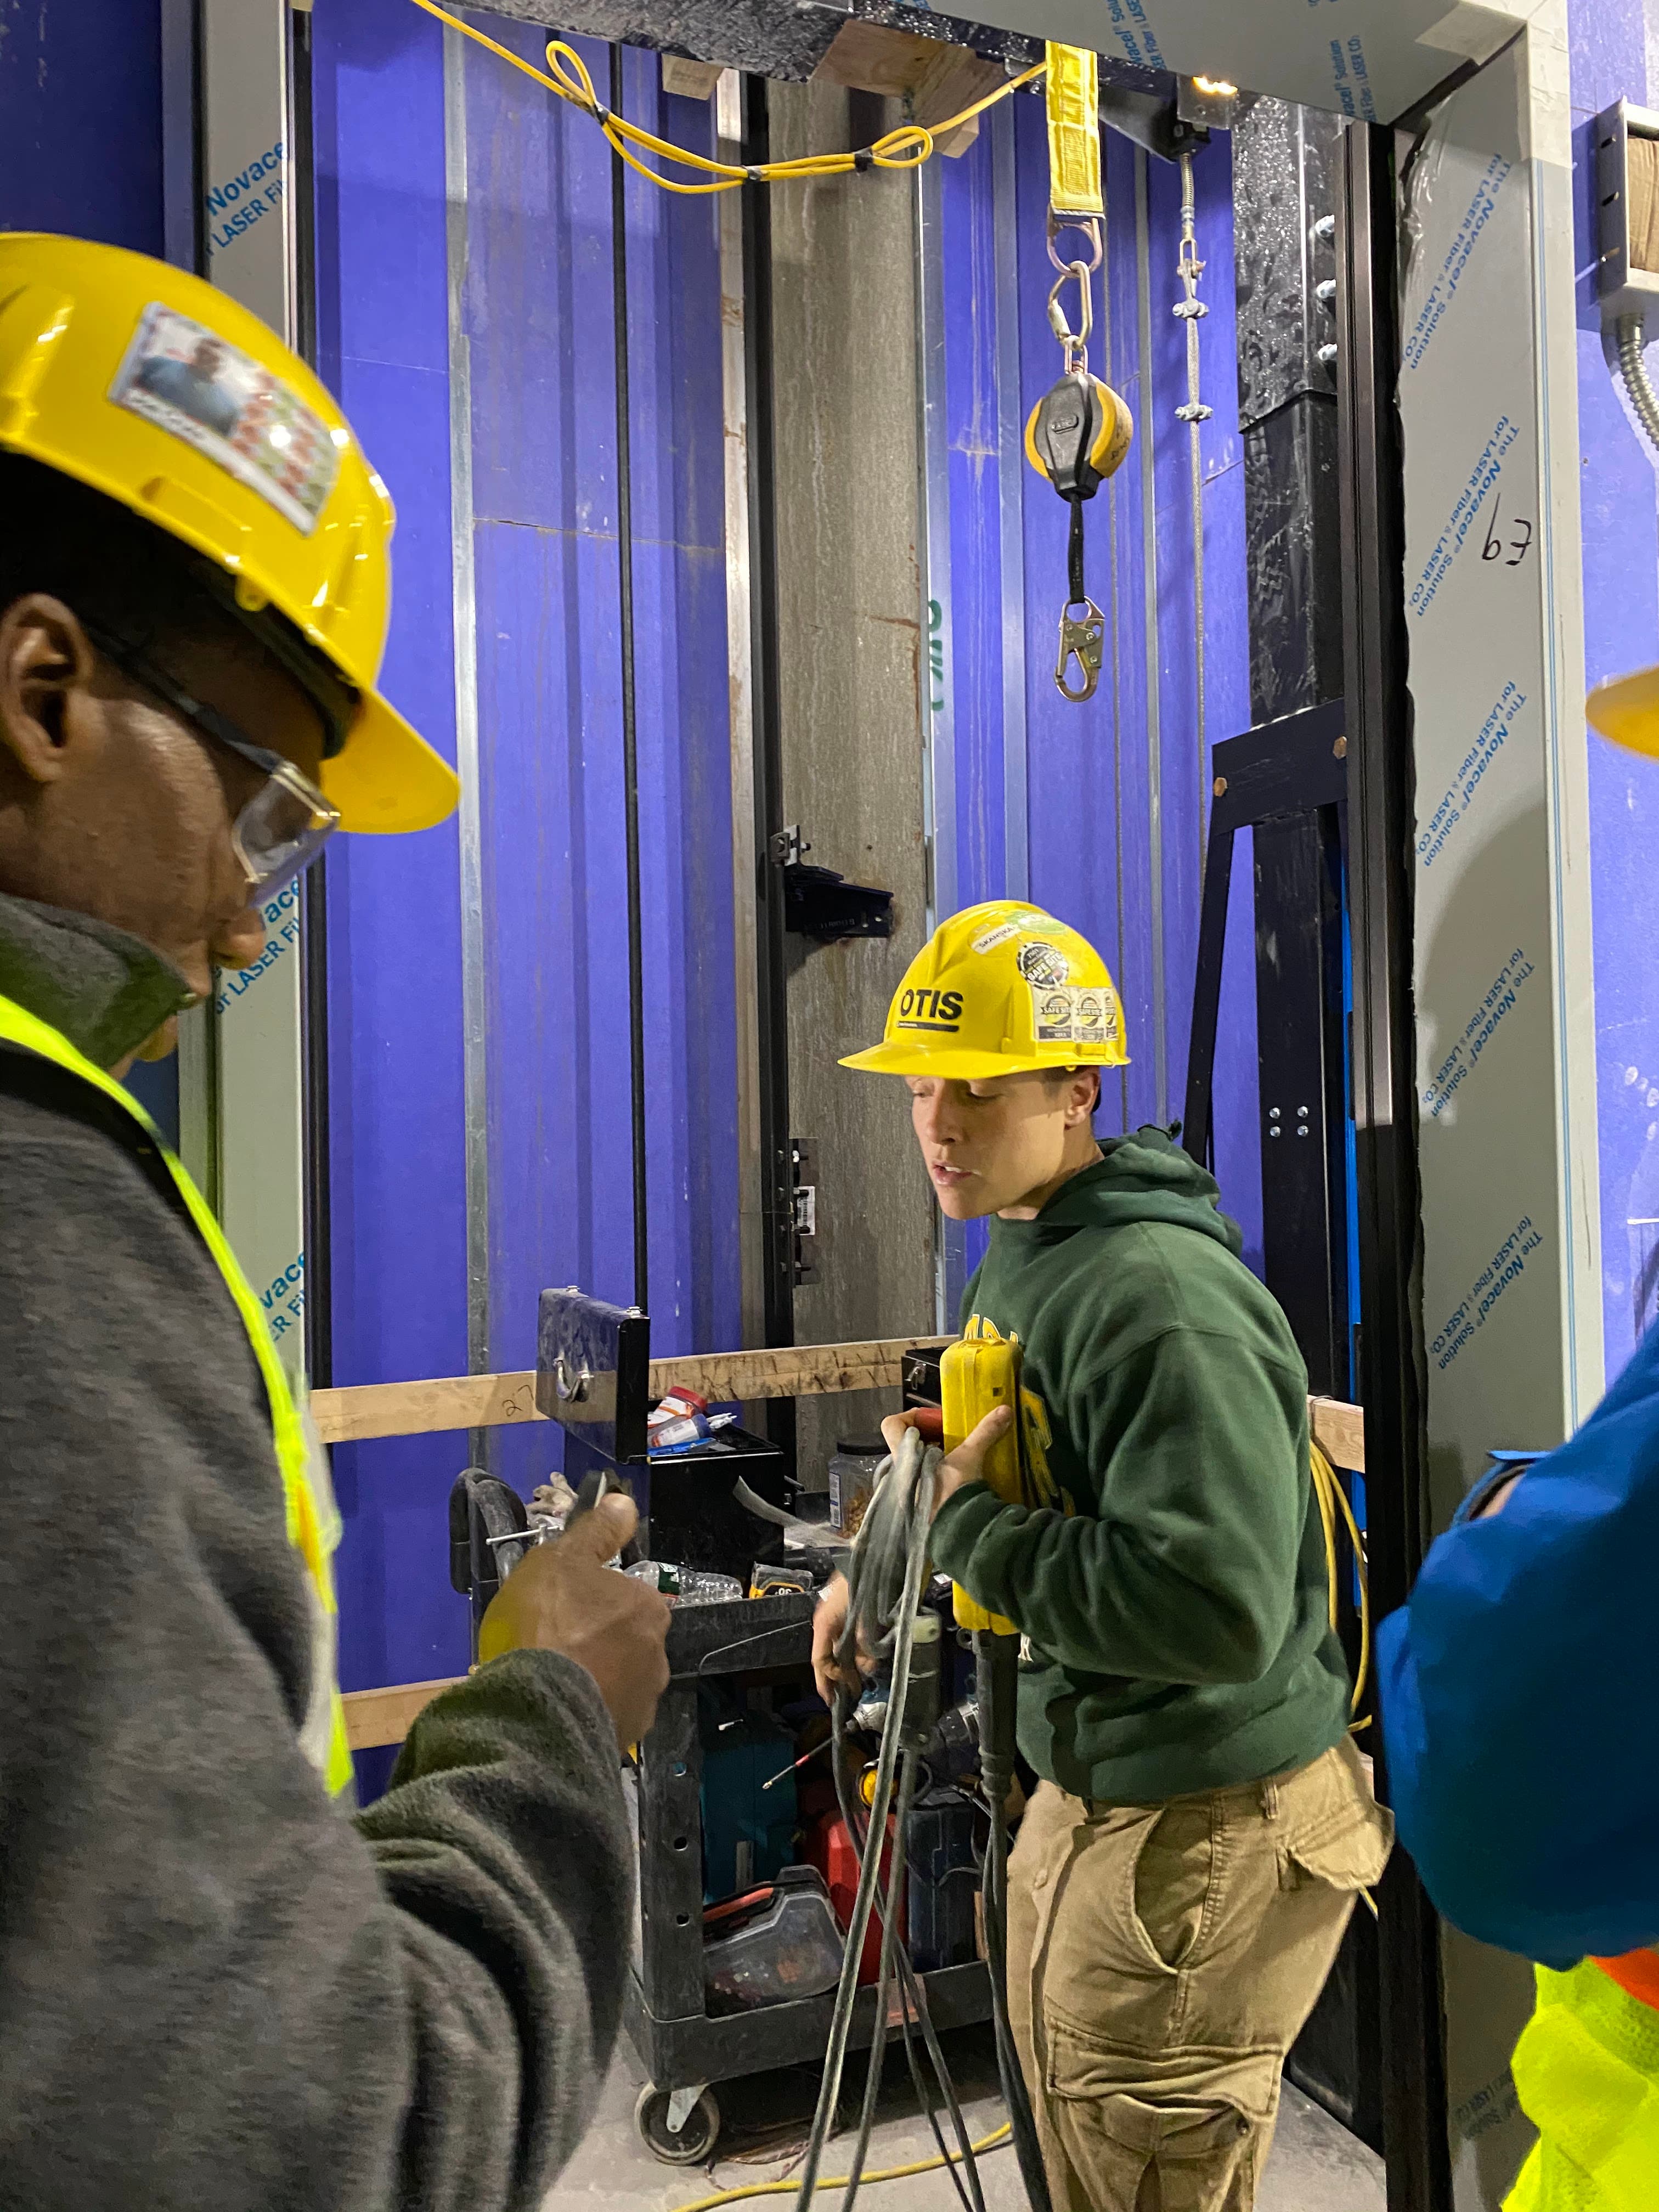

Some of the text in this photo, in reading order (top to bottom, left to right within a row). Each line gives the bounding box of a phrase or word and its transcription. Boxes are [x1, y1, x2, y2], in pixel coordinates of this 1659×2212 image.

[1330, 40, 1348, 80] Solution
[1486, 154, 1503, 176] for
[1492, 162, 1511, 194] The
[212, 199, 269, 247] LASER
[1462, 178, 1490, 230] LASER
[1443, 233, 1465, 273] Fiber
[1415, 285, 1441, 333] LASER
[1410, 302, 1446, 369] Solution
[1494, 415, 1509, 439] for
[1499, 426, 1520, 455] The
[1468, 439, 1497, 487] LASER
[1449, 488, 1472, 527] Fiber
[1421, 536, 1448, 581] LASER
[1417, 553, 1453, 617] Solution
[1501, 680, 1516, 703] for
[1506, 693, 1527, 721] The
[1476, 702, 1505, 747] LASER
[1458, 747, 1480, 781] Fiber
[1429, 790, 1455, 832] LASER
[1424, 809, 1460, 867] Solution
[227, 940, 286, 996] LASER
[1509, 948, 1525, 968] for
[1513, 962, 1535, 988] The
[900, 988, 964, 1020] OTIS
[1483, 967, 1511, 1008] LASER
[1464, 1006, 1488, 1039] Fiber
[1435, 1045, 1463, 1084] LASER
[1430, 1064, 1468, 1118] Solution
[1516, 1215, 1532, 1235] for
[1522, 1231, 1543, 1256] The
[1491, 1232, 1520, 1270] LASER
[1472, 1267, 1495, 1297] Fiber
[1443, 1301, 1471, 1338] LASER
[1438, 1322, 1475, 1370] Solution
